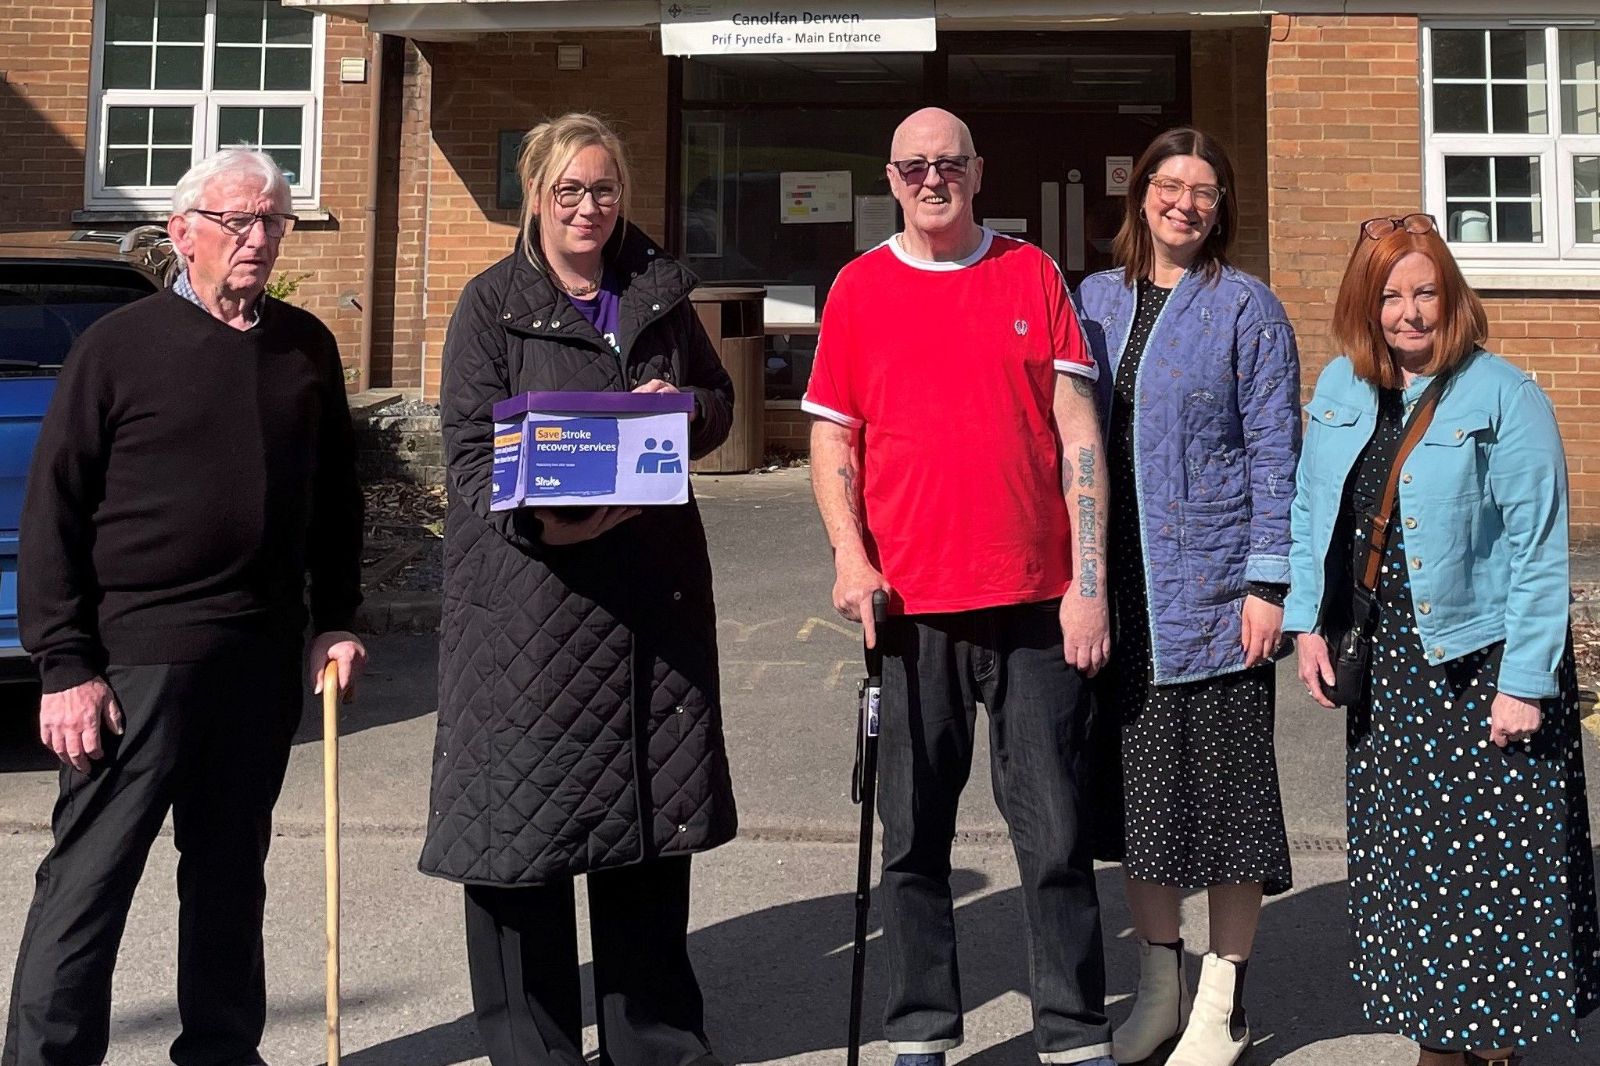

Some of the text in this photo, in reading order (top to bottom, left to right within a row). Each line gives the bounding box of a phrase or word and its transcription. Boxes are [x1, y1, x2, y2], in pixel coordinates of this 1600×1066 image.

[732, 12, 860, 26] Canolfan Derwen
[712, 33, 733, 46] Prif
[736, 33, 783, 48] Fynedfa
[795, 33, 825, 44] Main
[828, 32, 881, 43] Entrance
[537, 429, 591, 440] Save stroke
[537, 442, 616, 454] recovery services
[535, 475, 561, 486] Stroke
[1078, 444, 1097, 598] NORTHERN SOUL
